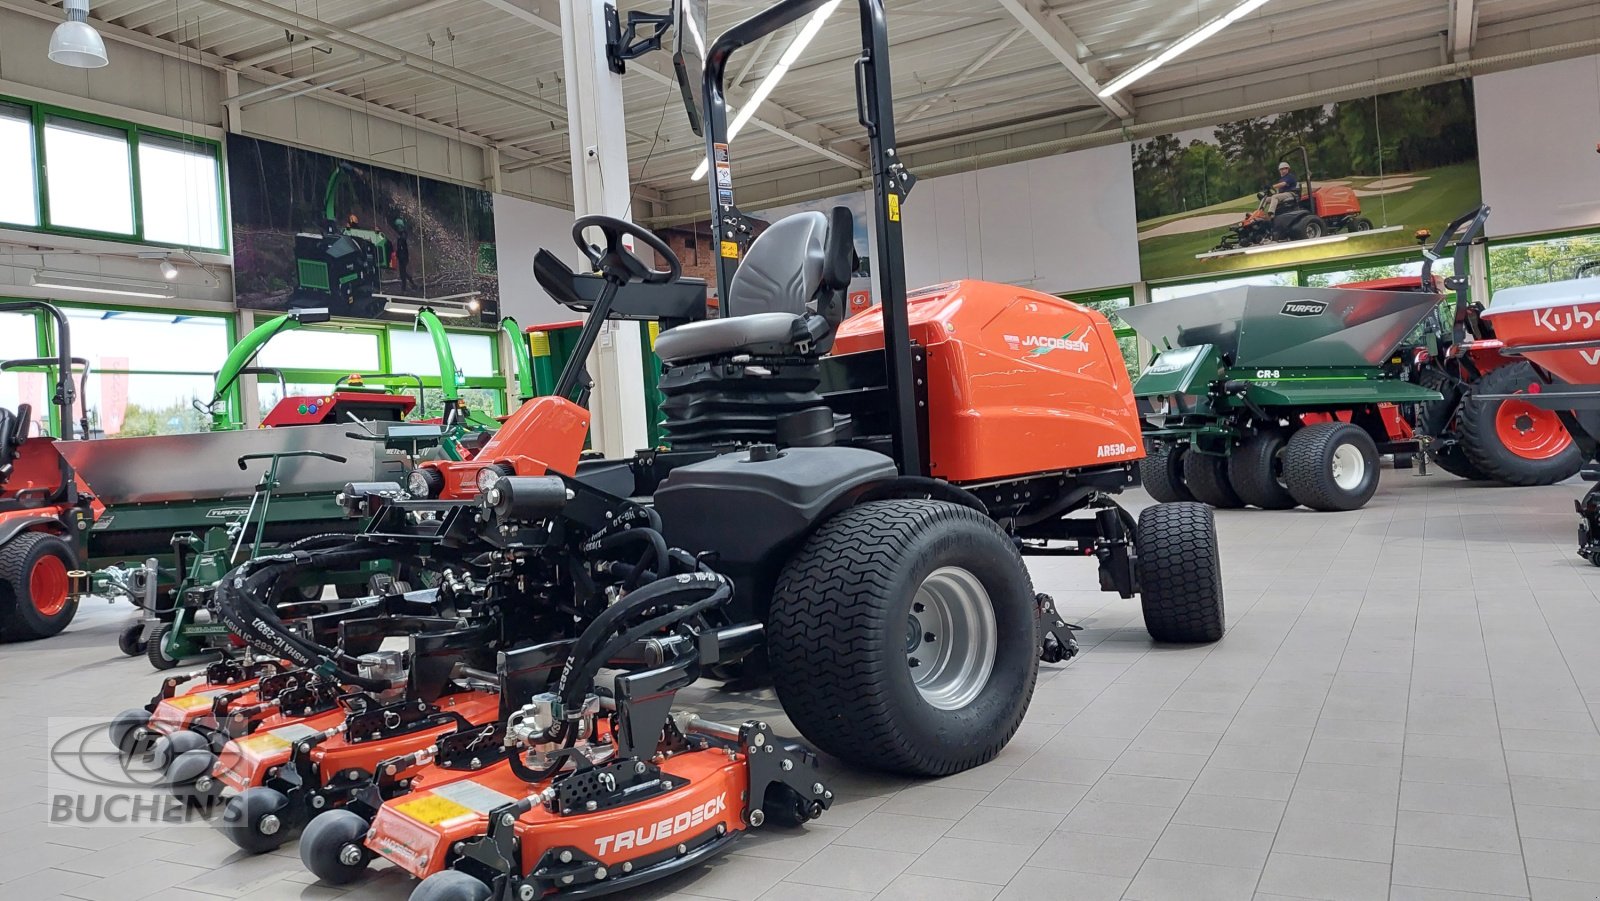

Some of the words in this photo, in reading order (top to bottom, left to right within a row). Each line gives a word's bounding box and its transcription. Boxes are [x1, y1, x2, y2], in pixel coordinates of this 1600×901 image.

[1285, 303, 1323, 313] TURFCO
[1533, 306, 1600, 332] Kub
[1022, 335, 1089, 353] JACOBSEN
[1256, 369, 1280, 379] CR-8
[1096, 443, 1126, 458] AR530
[211, 508, 249, 516] TURFCO
[283, 644, 310, 665] MSHA
[594, 791, 727, 857] TRUEDECK
